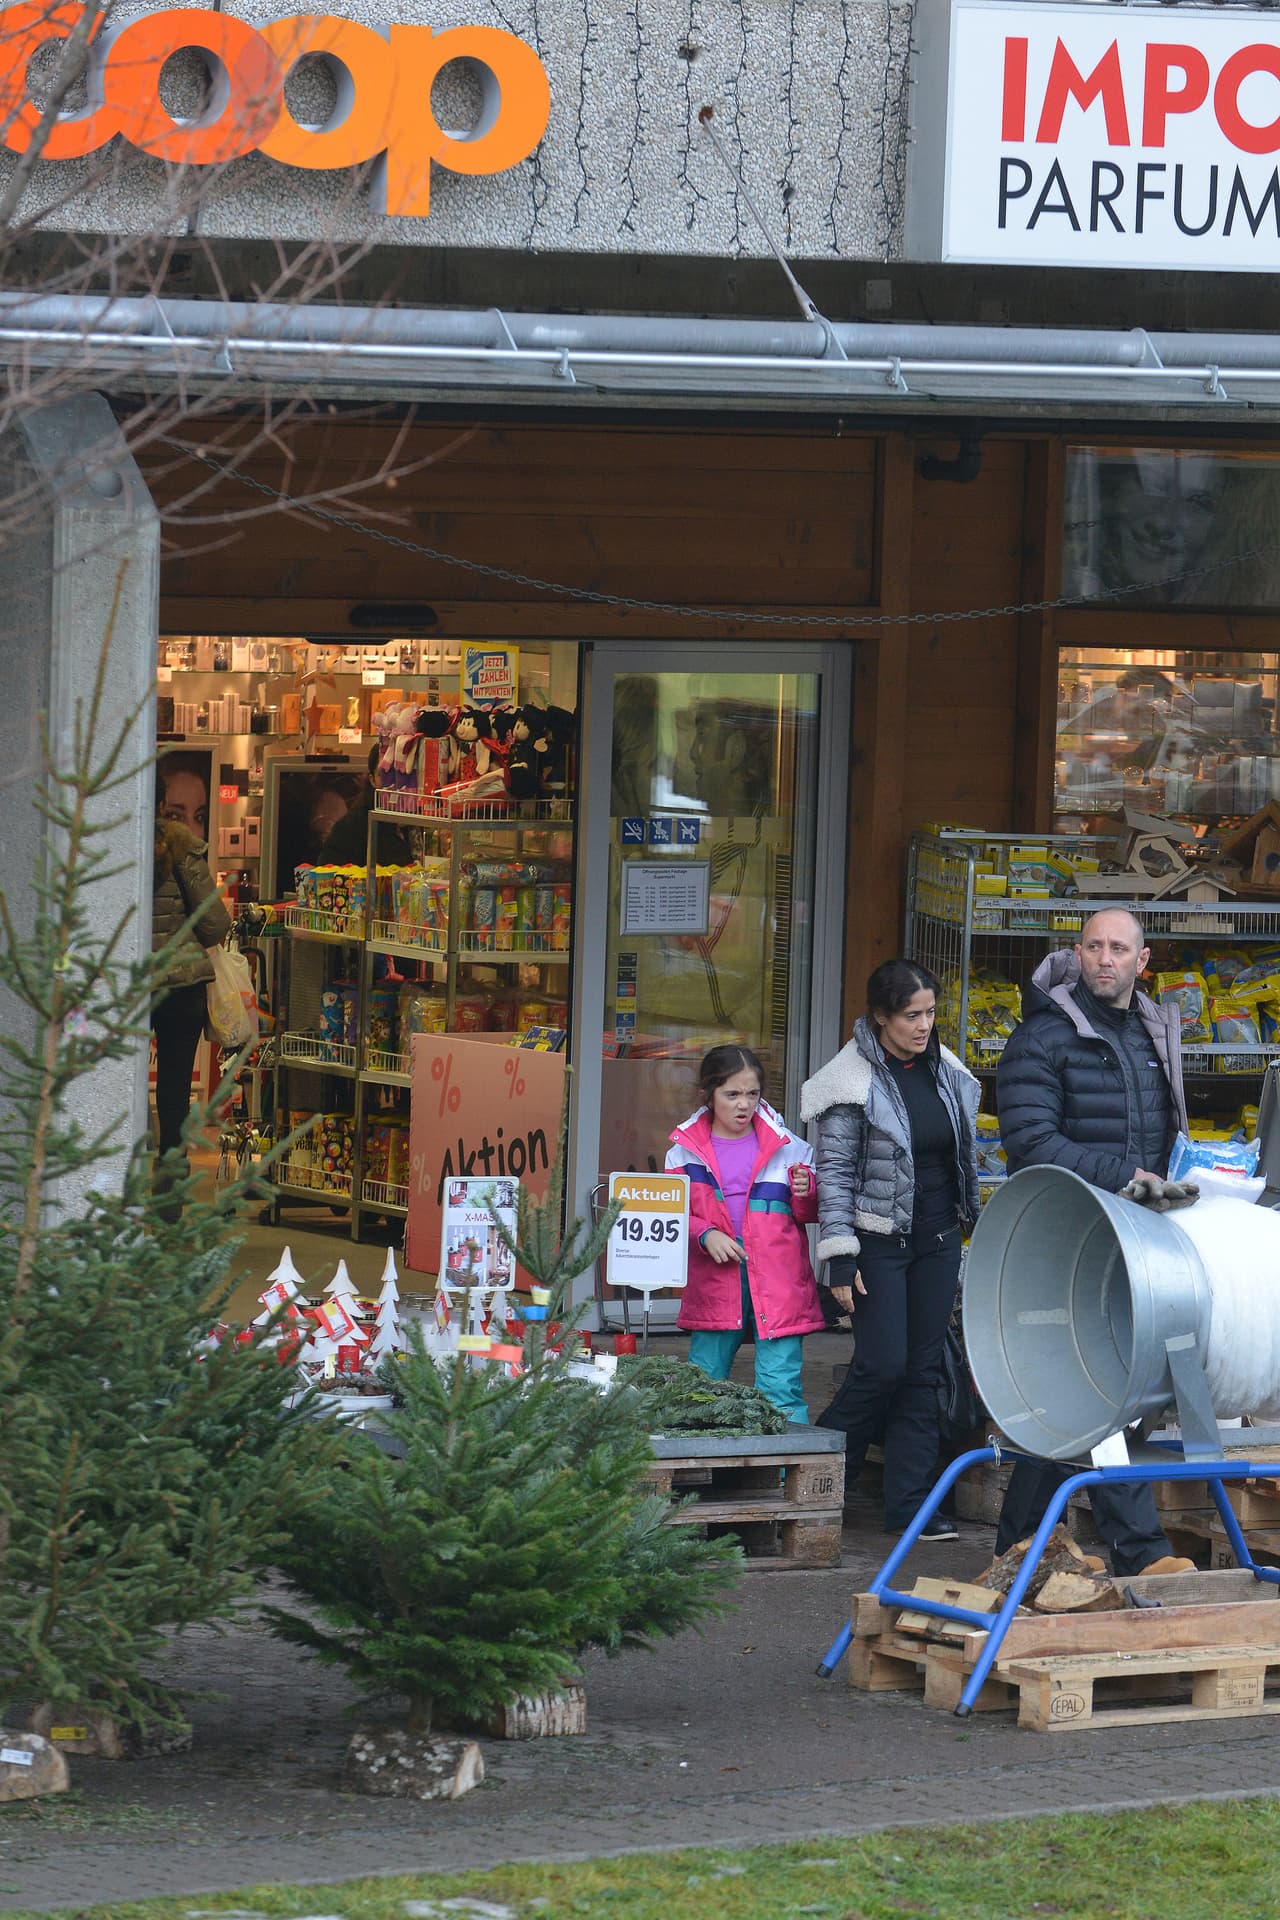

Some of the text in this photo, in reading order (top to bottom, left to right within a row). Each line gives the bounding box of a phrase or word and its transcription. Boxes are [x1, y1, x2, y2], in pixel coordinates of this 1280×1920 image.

[0, 2, 550, 217] coop
[998, 156, 1280, 239] PARFUM
[484, 656, 504, 667] JETZT
[479, 669, 509, 684] ZAHLEN
[473, 687, 484, 696] MIT
[437, 1127, 549, 1207] Aktion
[617, 1187, 680, 1202] Aktuell
[464, 1213, 495, 1222] X-MAS
[616, 1217, 680, 1243] 19.95
[812, 1477, 833, 1494] EUR
[1056, 1700, 1080, 1714] EPAL
